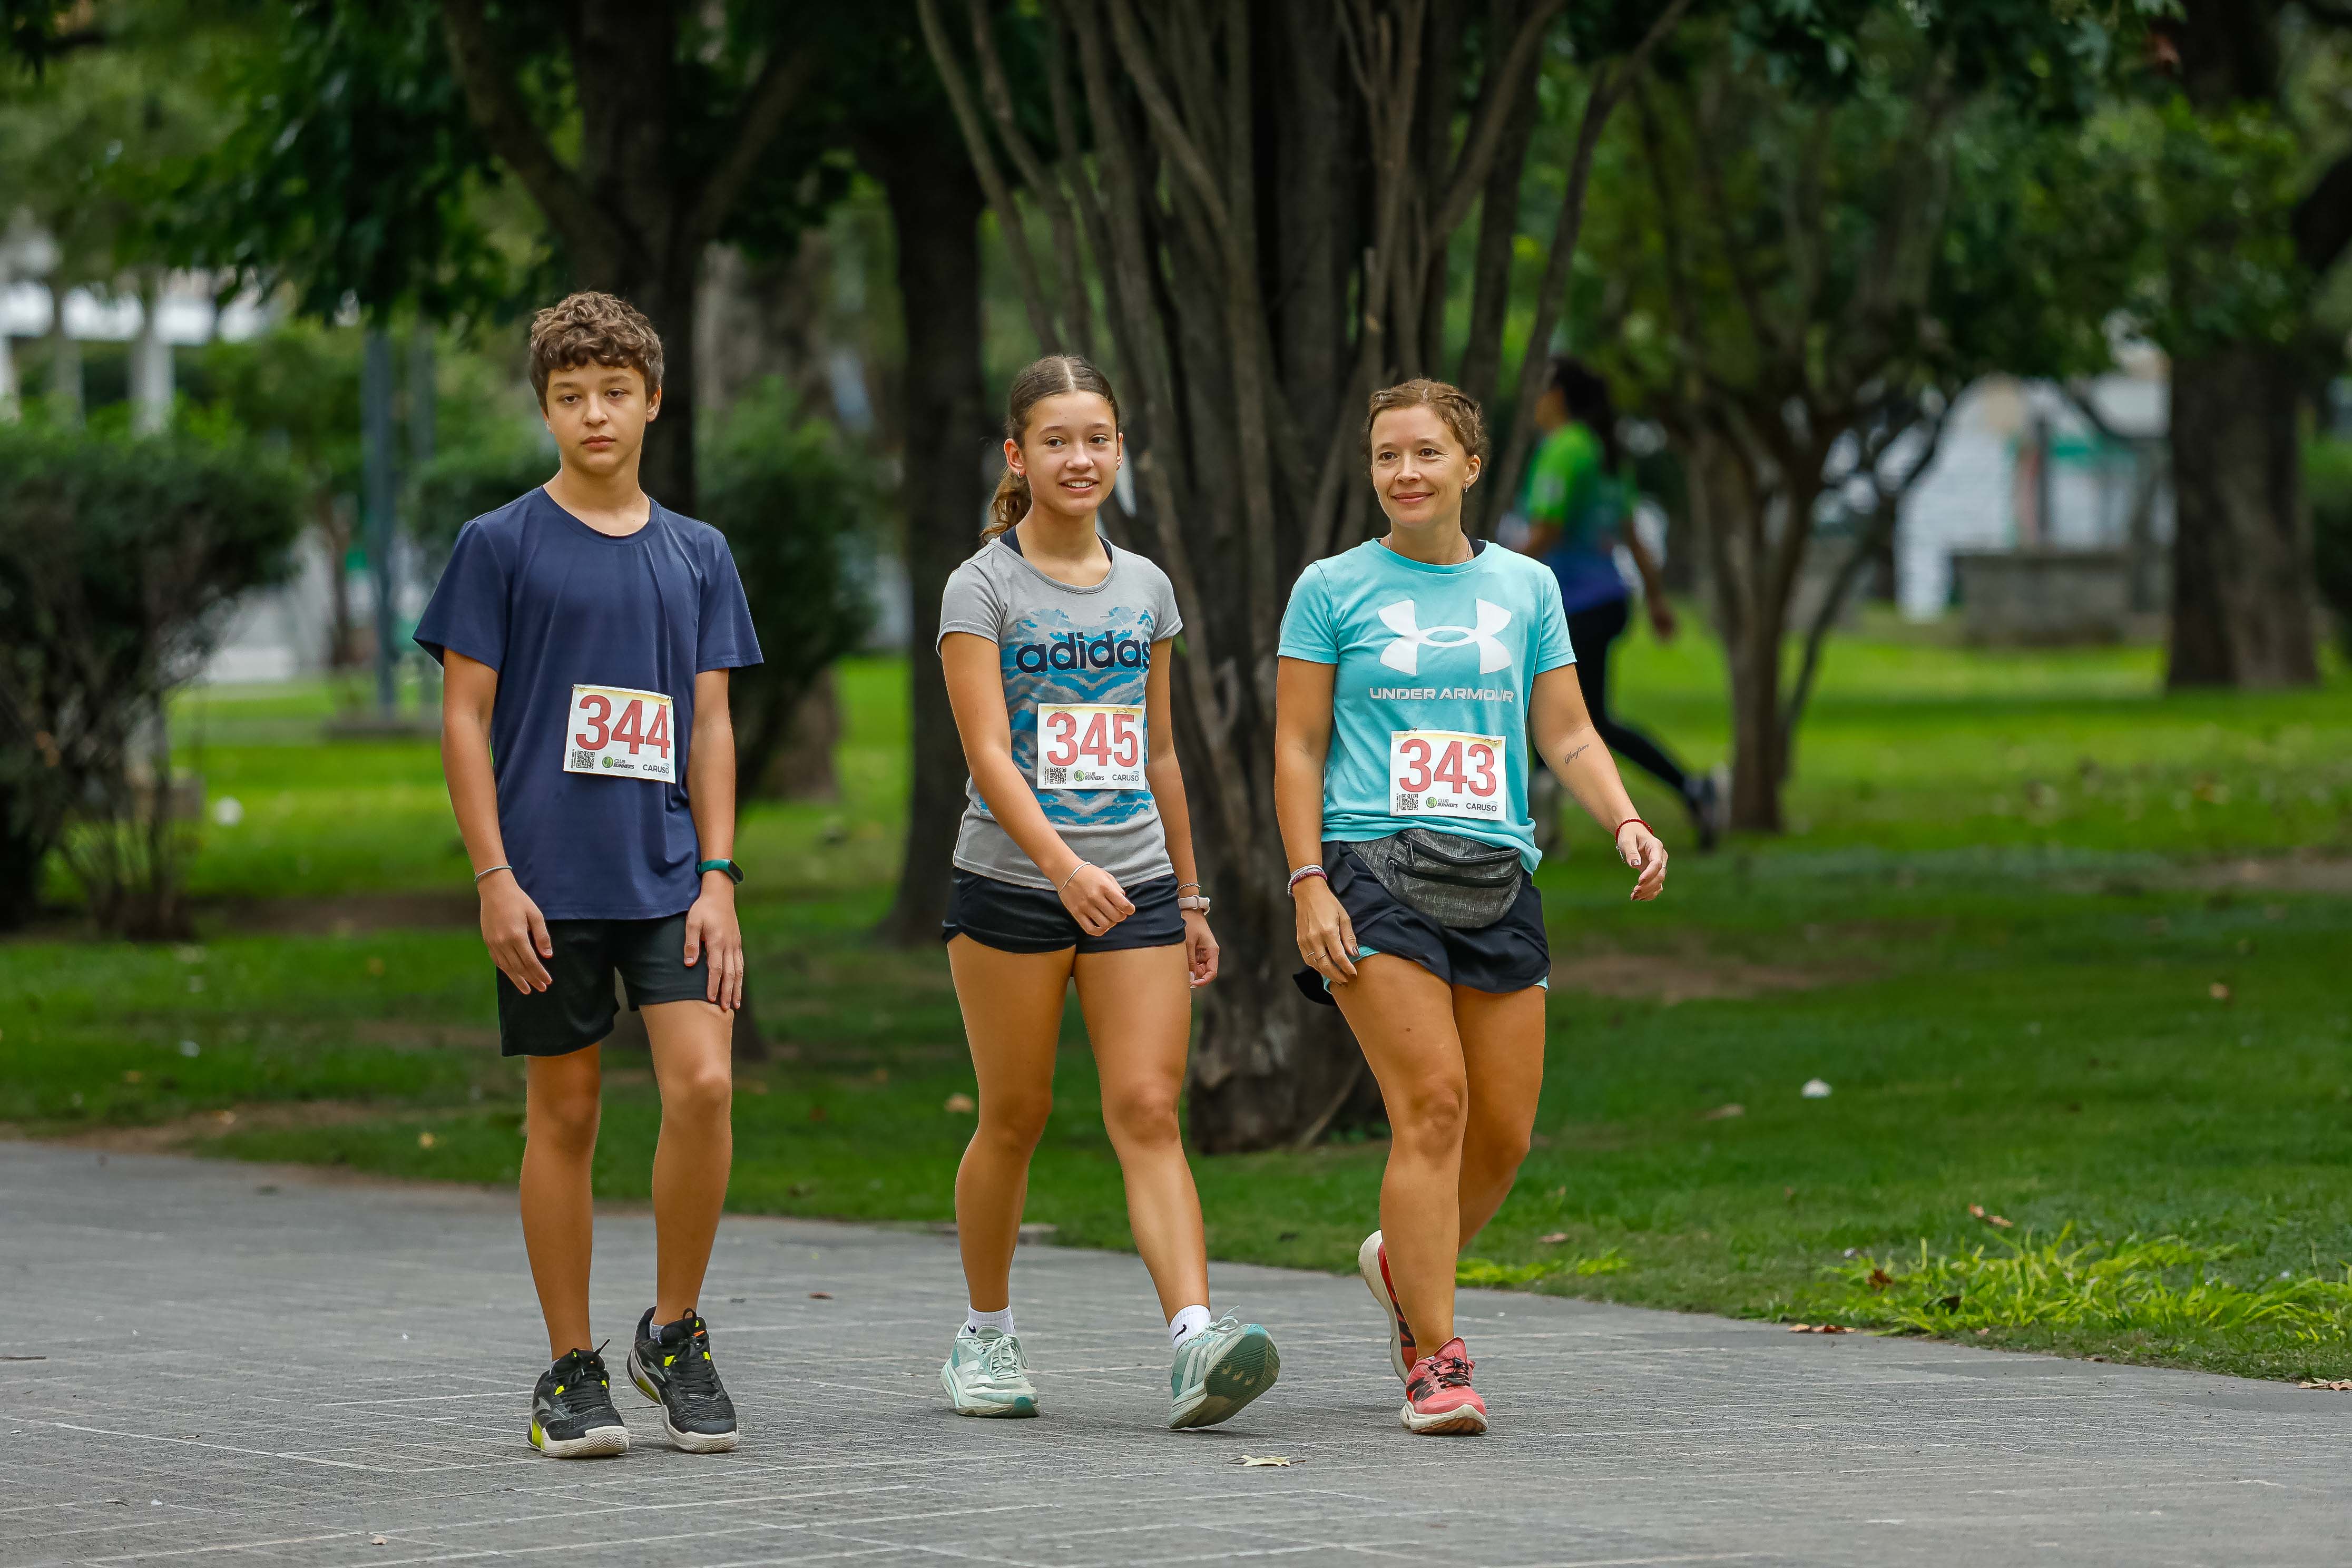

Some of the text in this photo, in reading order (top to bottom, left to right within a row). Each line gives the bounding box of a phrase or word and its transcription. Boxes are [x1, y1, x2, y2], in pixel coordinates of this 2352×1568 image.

[1015, 630, 1151, 673] adidas
[1369, 687, 1514, 702] UNDER ARMOUR
[575, 694, 670, 759] 344
[1046, 712, 1138, 768] 345
[642, 764, 670, 774] CARUSO
[1399, 739, 1496, 797] 343
[1466, 802, 1497, 812] CARUSO
